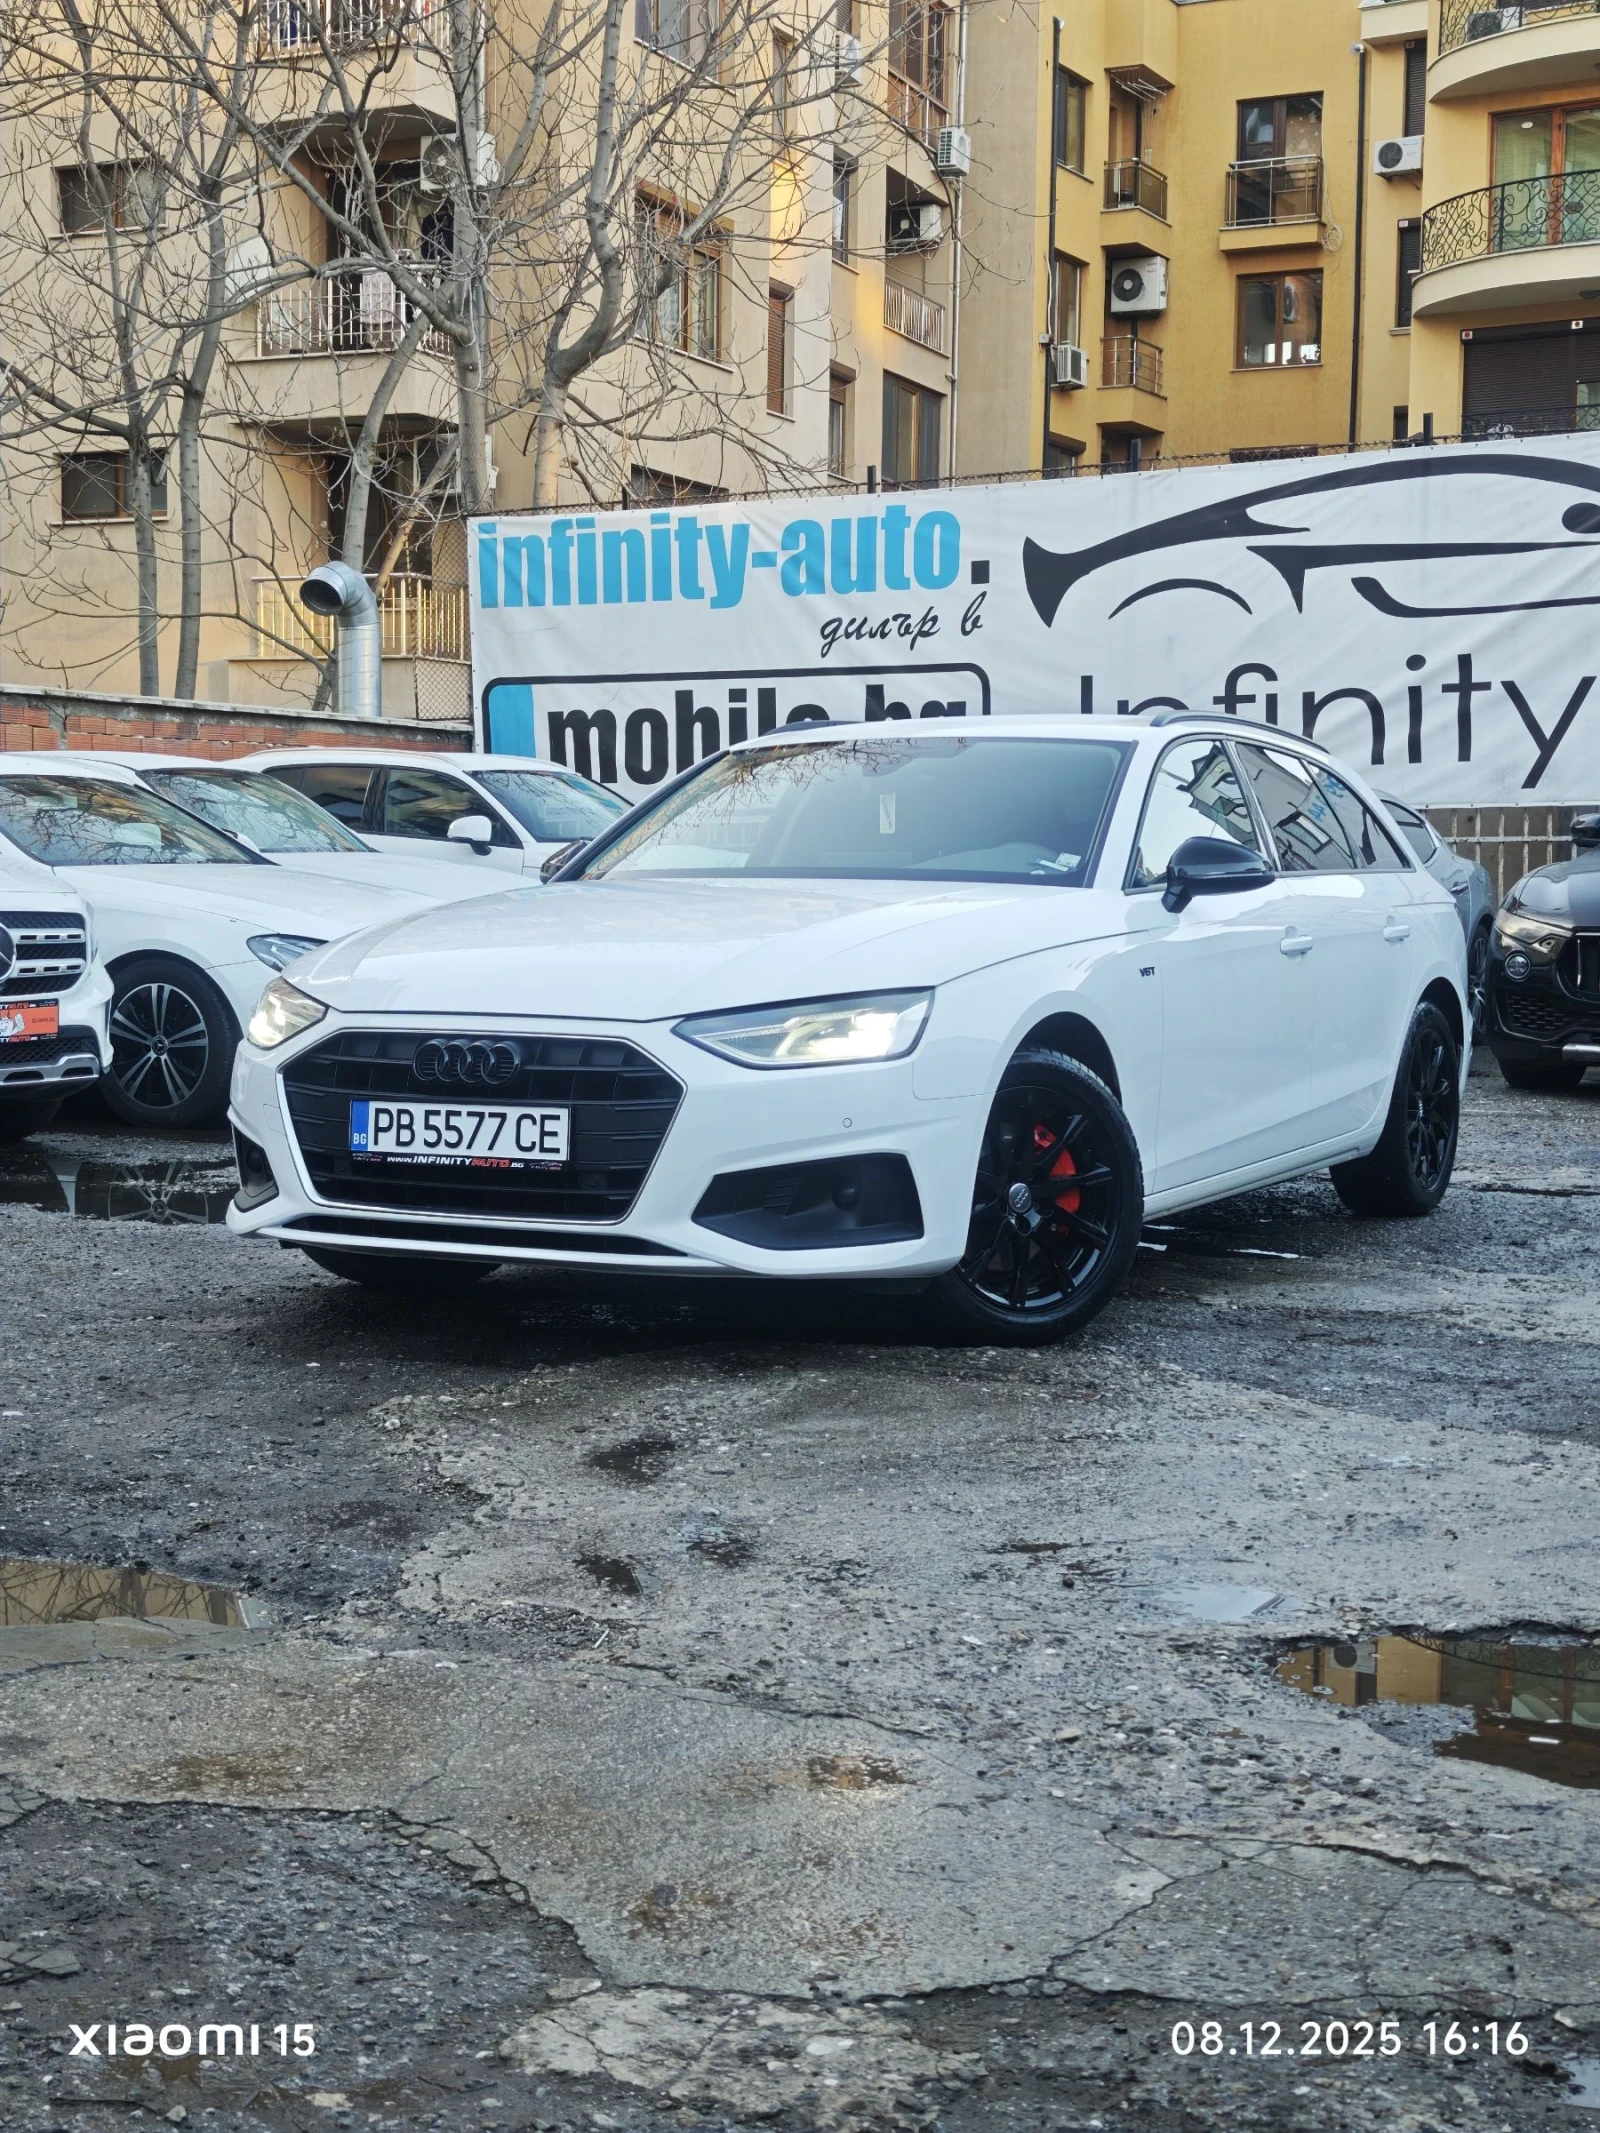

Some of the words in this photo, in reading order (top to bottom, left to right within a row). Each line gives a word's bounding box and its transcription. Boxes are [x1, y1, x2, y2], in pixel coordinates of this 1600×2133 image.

[820, 606, 941, 658] дилър
[1081, 653, 1598, 789] finity
[353, 1133, 367, 1145] BG
[373, 1107, 416, 1147] PB
[423, 1109, 508, 1151] 5577
[515, 1113, 561, 1154] CE
